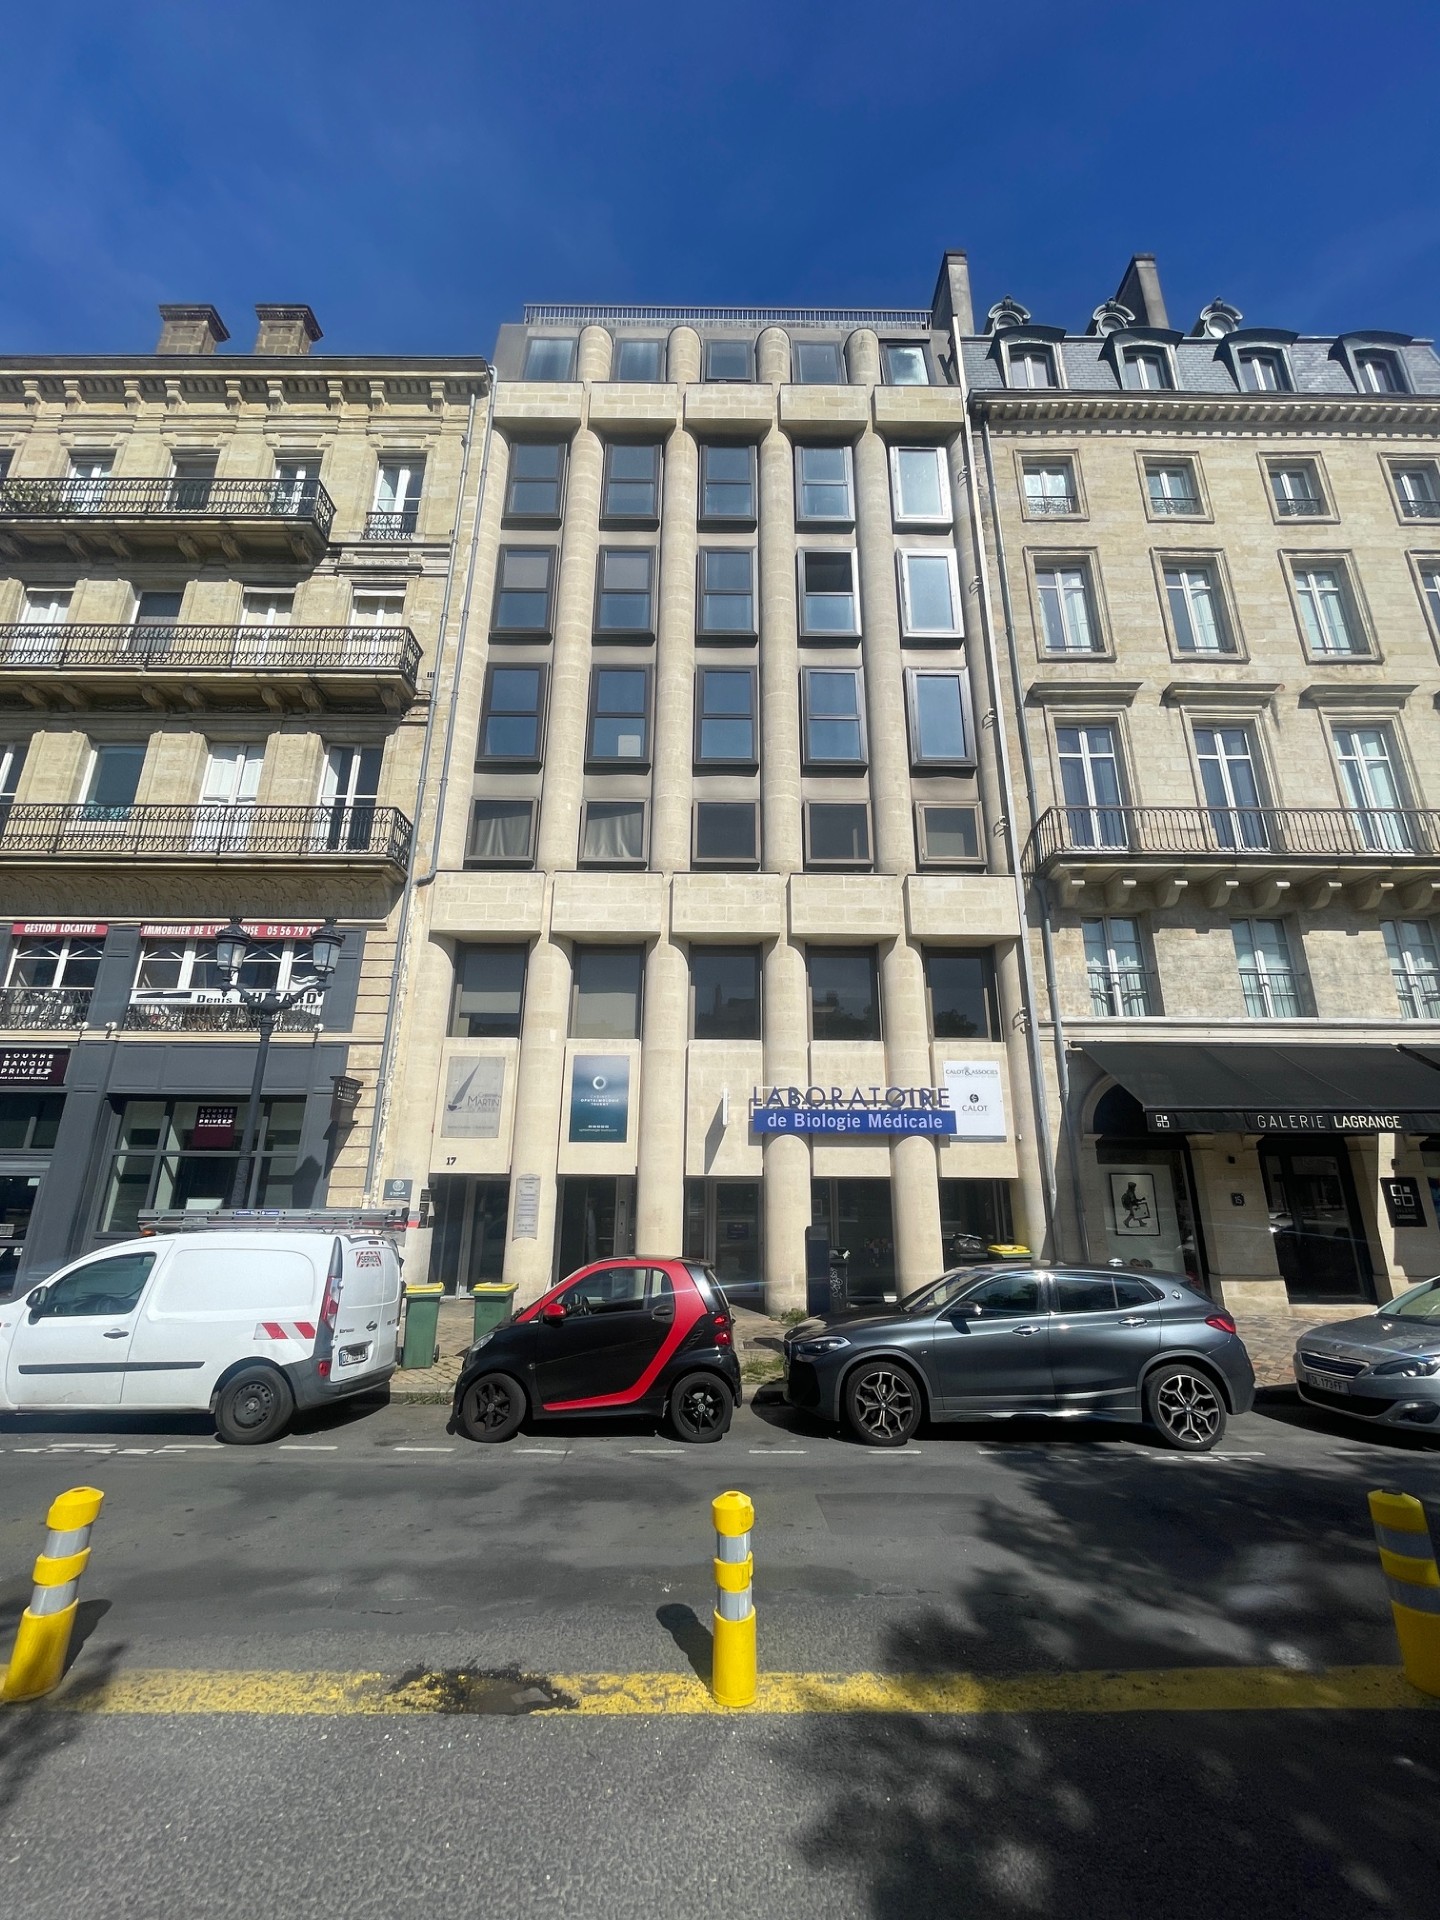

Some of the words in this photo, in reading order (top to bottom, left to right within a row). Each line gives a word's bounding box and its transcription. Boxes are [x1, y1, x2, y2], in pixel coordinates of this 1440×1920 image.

[24, 923, 57, 933] GESTION
[60, 923, 97, 933] LOCATIVE
[143, 925, 191, 935] IMMOBILIER
[193, 925, 204, 935] DE
[267, 925, 278, 936] 05
[280, 925, 291, 936] 56
[293, 926, 304, 936] 79
[196, 994, 232, 1004] Denis
[467, 1096, 500, 1107] MARTIN
[753, 1086, 950, 1109] LABORATOIRE
[961, 1104, 988, 1112] CALOT
[767, 1112, 787, 1128] de
[794, 1112, 861, 1130] Biologie
[868, 1113, 943, 1129] Médicale
[1257, 1115, 1326, 1129] GALERIE
[1333, 1115, 1402, 1129] LAGRANGE
[446, 1156, 457, 1166] 17
